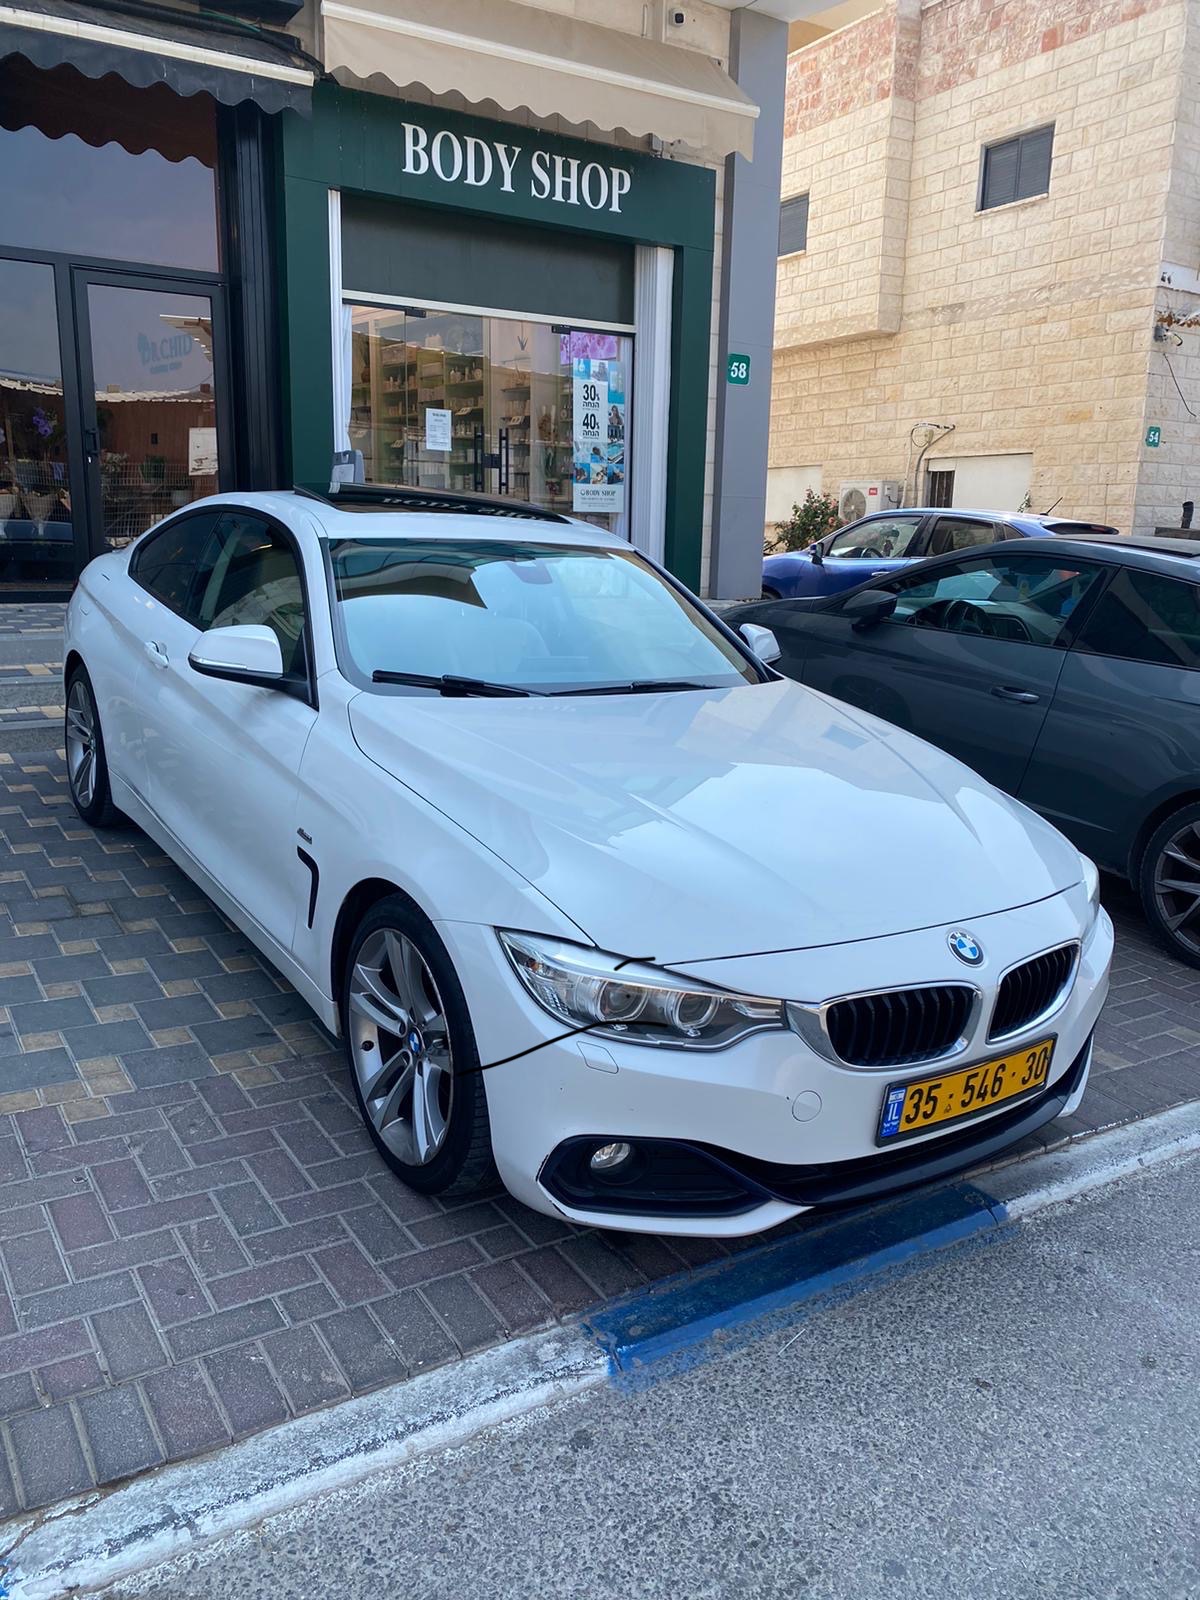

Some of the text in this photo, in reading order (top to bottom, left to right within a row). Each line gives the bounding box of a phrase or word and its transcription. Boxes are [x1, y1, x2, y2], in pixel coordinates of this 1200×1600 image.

[401, 122, 631, 213] BODY SHOP
[730, 361, 747, 379] 58
[1148, 431, 1159, 443] 54
[888, 1102, 899, 1121] IL
